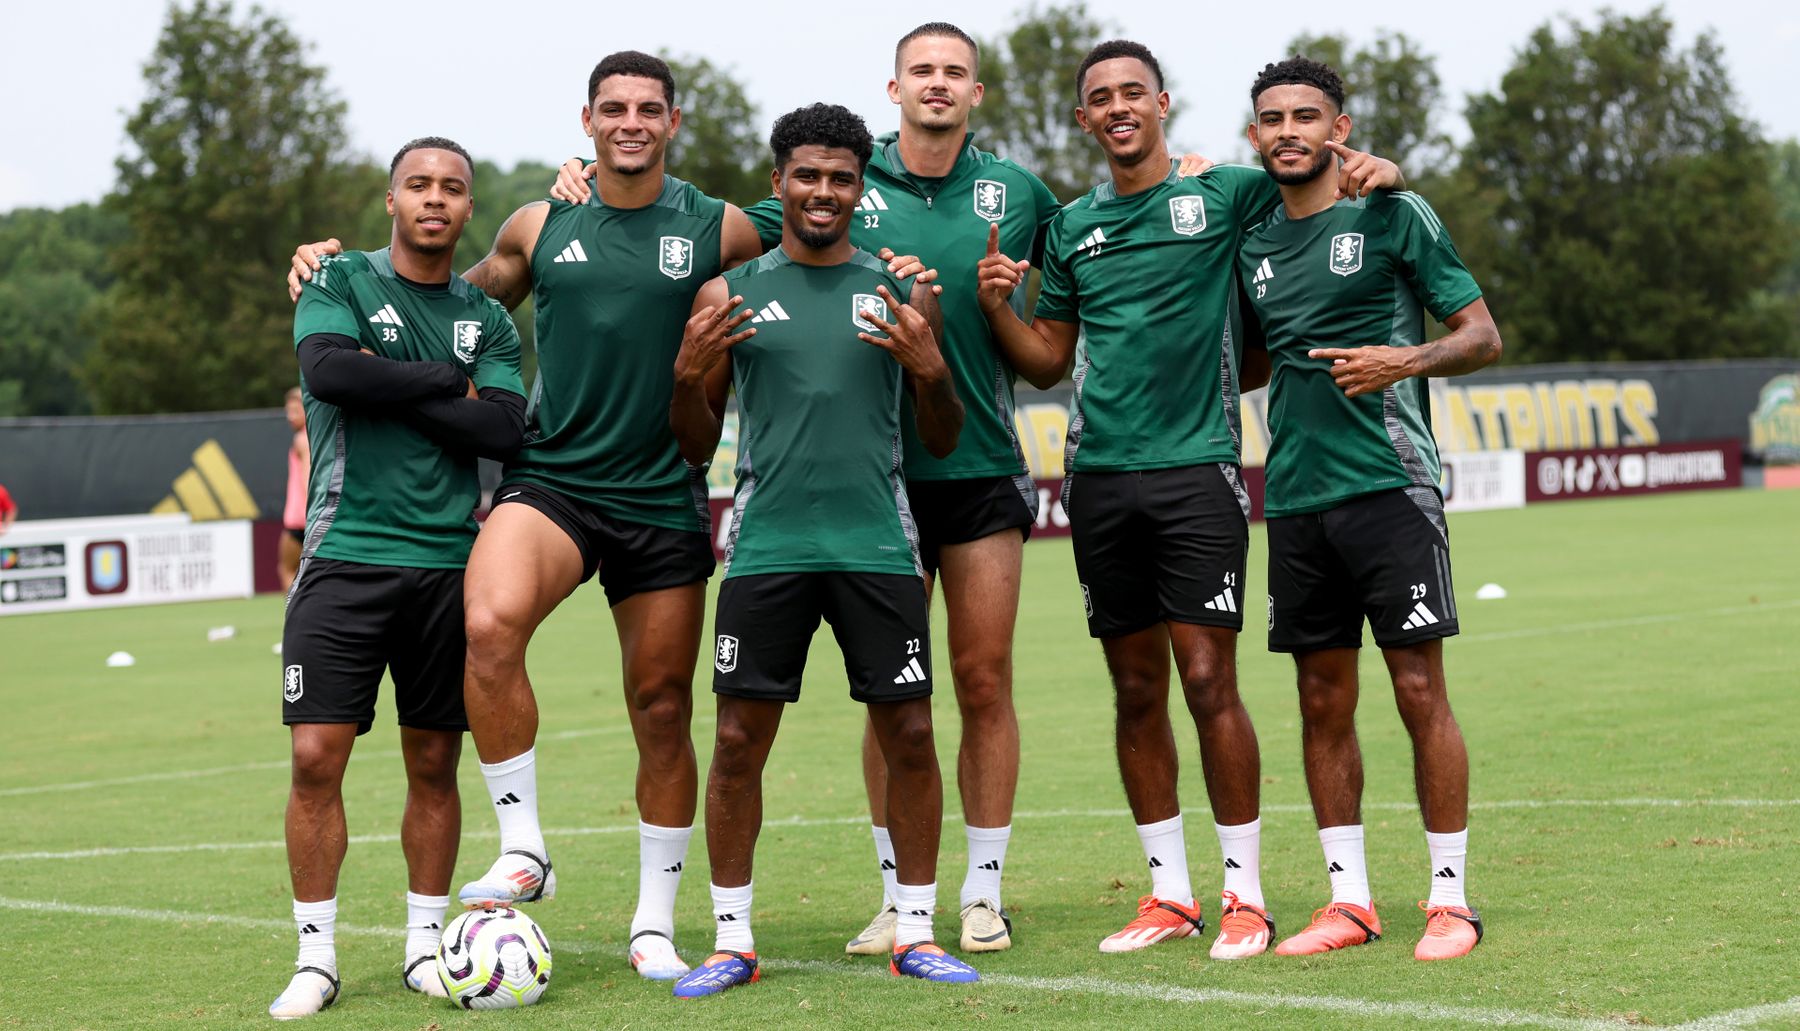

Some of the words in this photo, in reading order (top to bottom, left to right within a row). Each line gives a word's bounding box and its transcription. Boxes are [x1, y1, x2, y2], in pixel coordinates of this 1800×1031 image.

[864, 215, 880, 229] 32
[1256, 283, 1267, 299] 29
[382, 327, 398, 342] 35
[1223, 571, 1236, 587] 41
[1410, 582, 1427, 600] 29
[906, 638, 921, 655] 22
